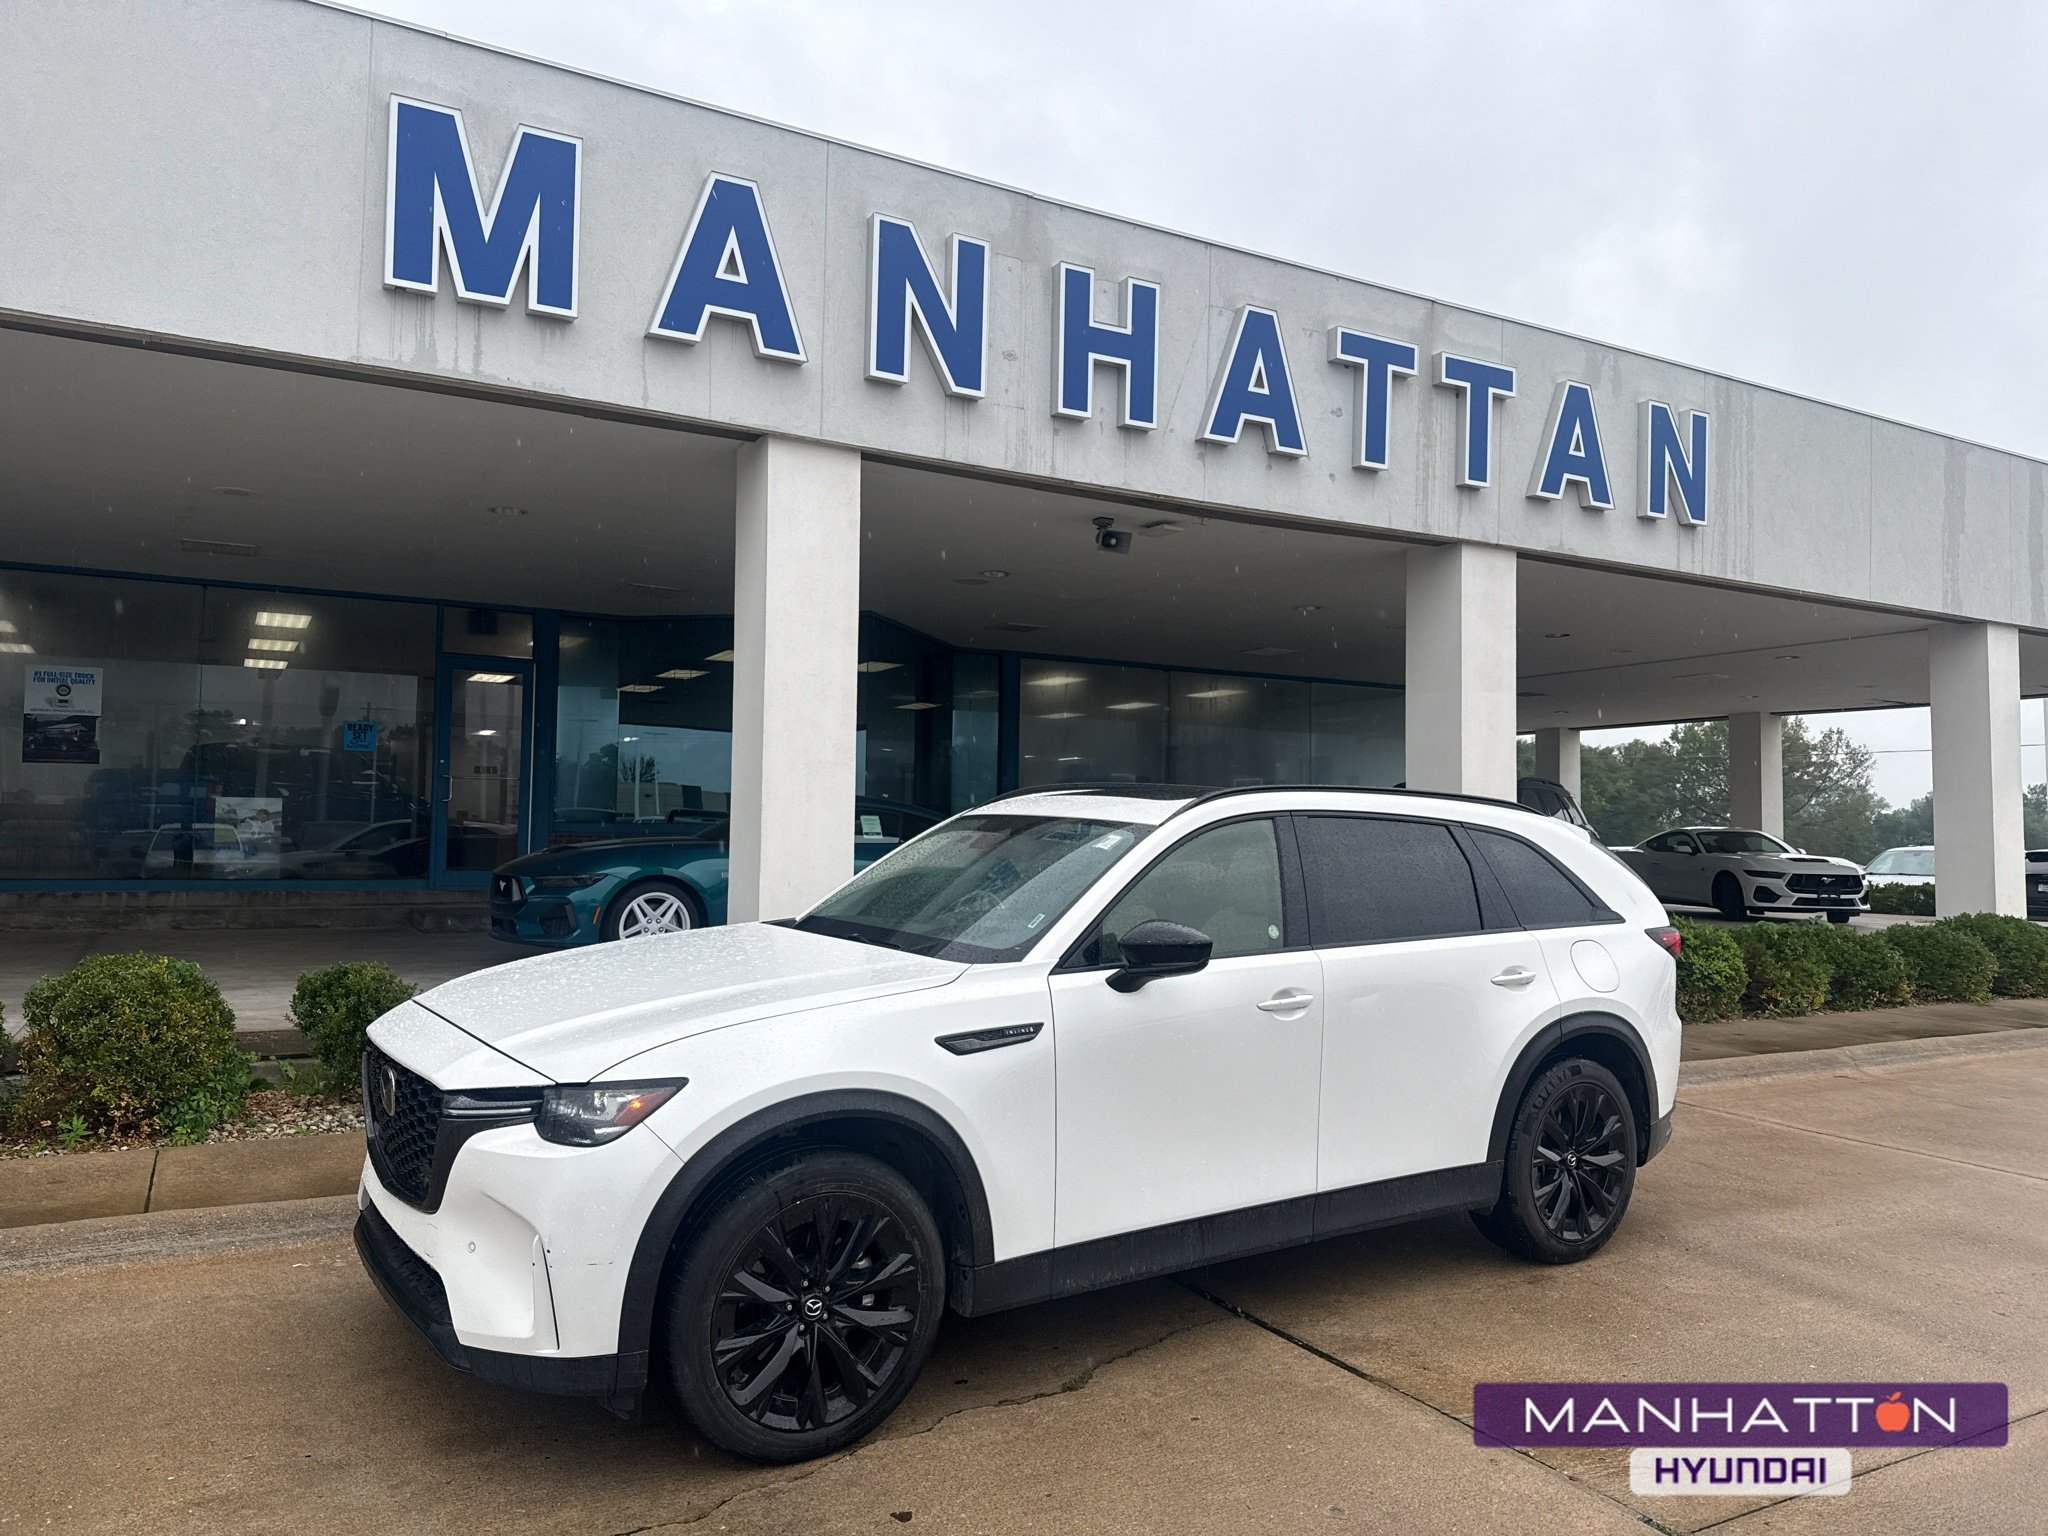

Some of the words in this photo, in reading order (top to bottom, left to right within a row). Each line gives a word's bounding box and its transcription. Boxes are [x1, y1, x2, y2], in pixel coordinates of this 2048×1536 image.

[383, 93, 1710, 527] MANHATTAN
[43, 671, 73, 679] FULL-SIZE
[69, 678, 96, 686] QUALITY
[347, 723, 374, 732] READY
[352, 731, 367, 740] SET
